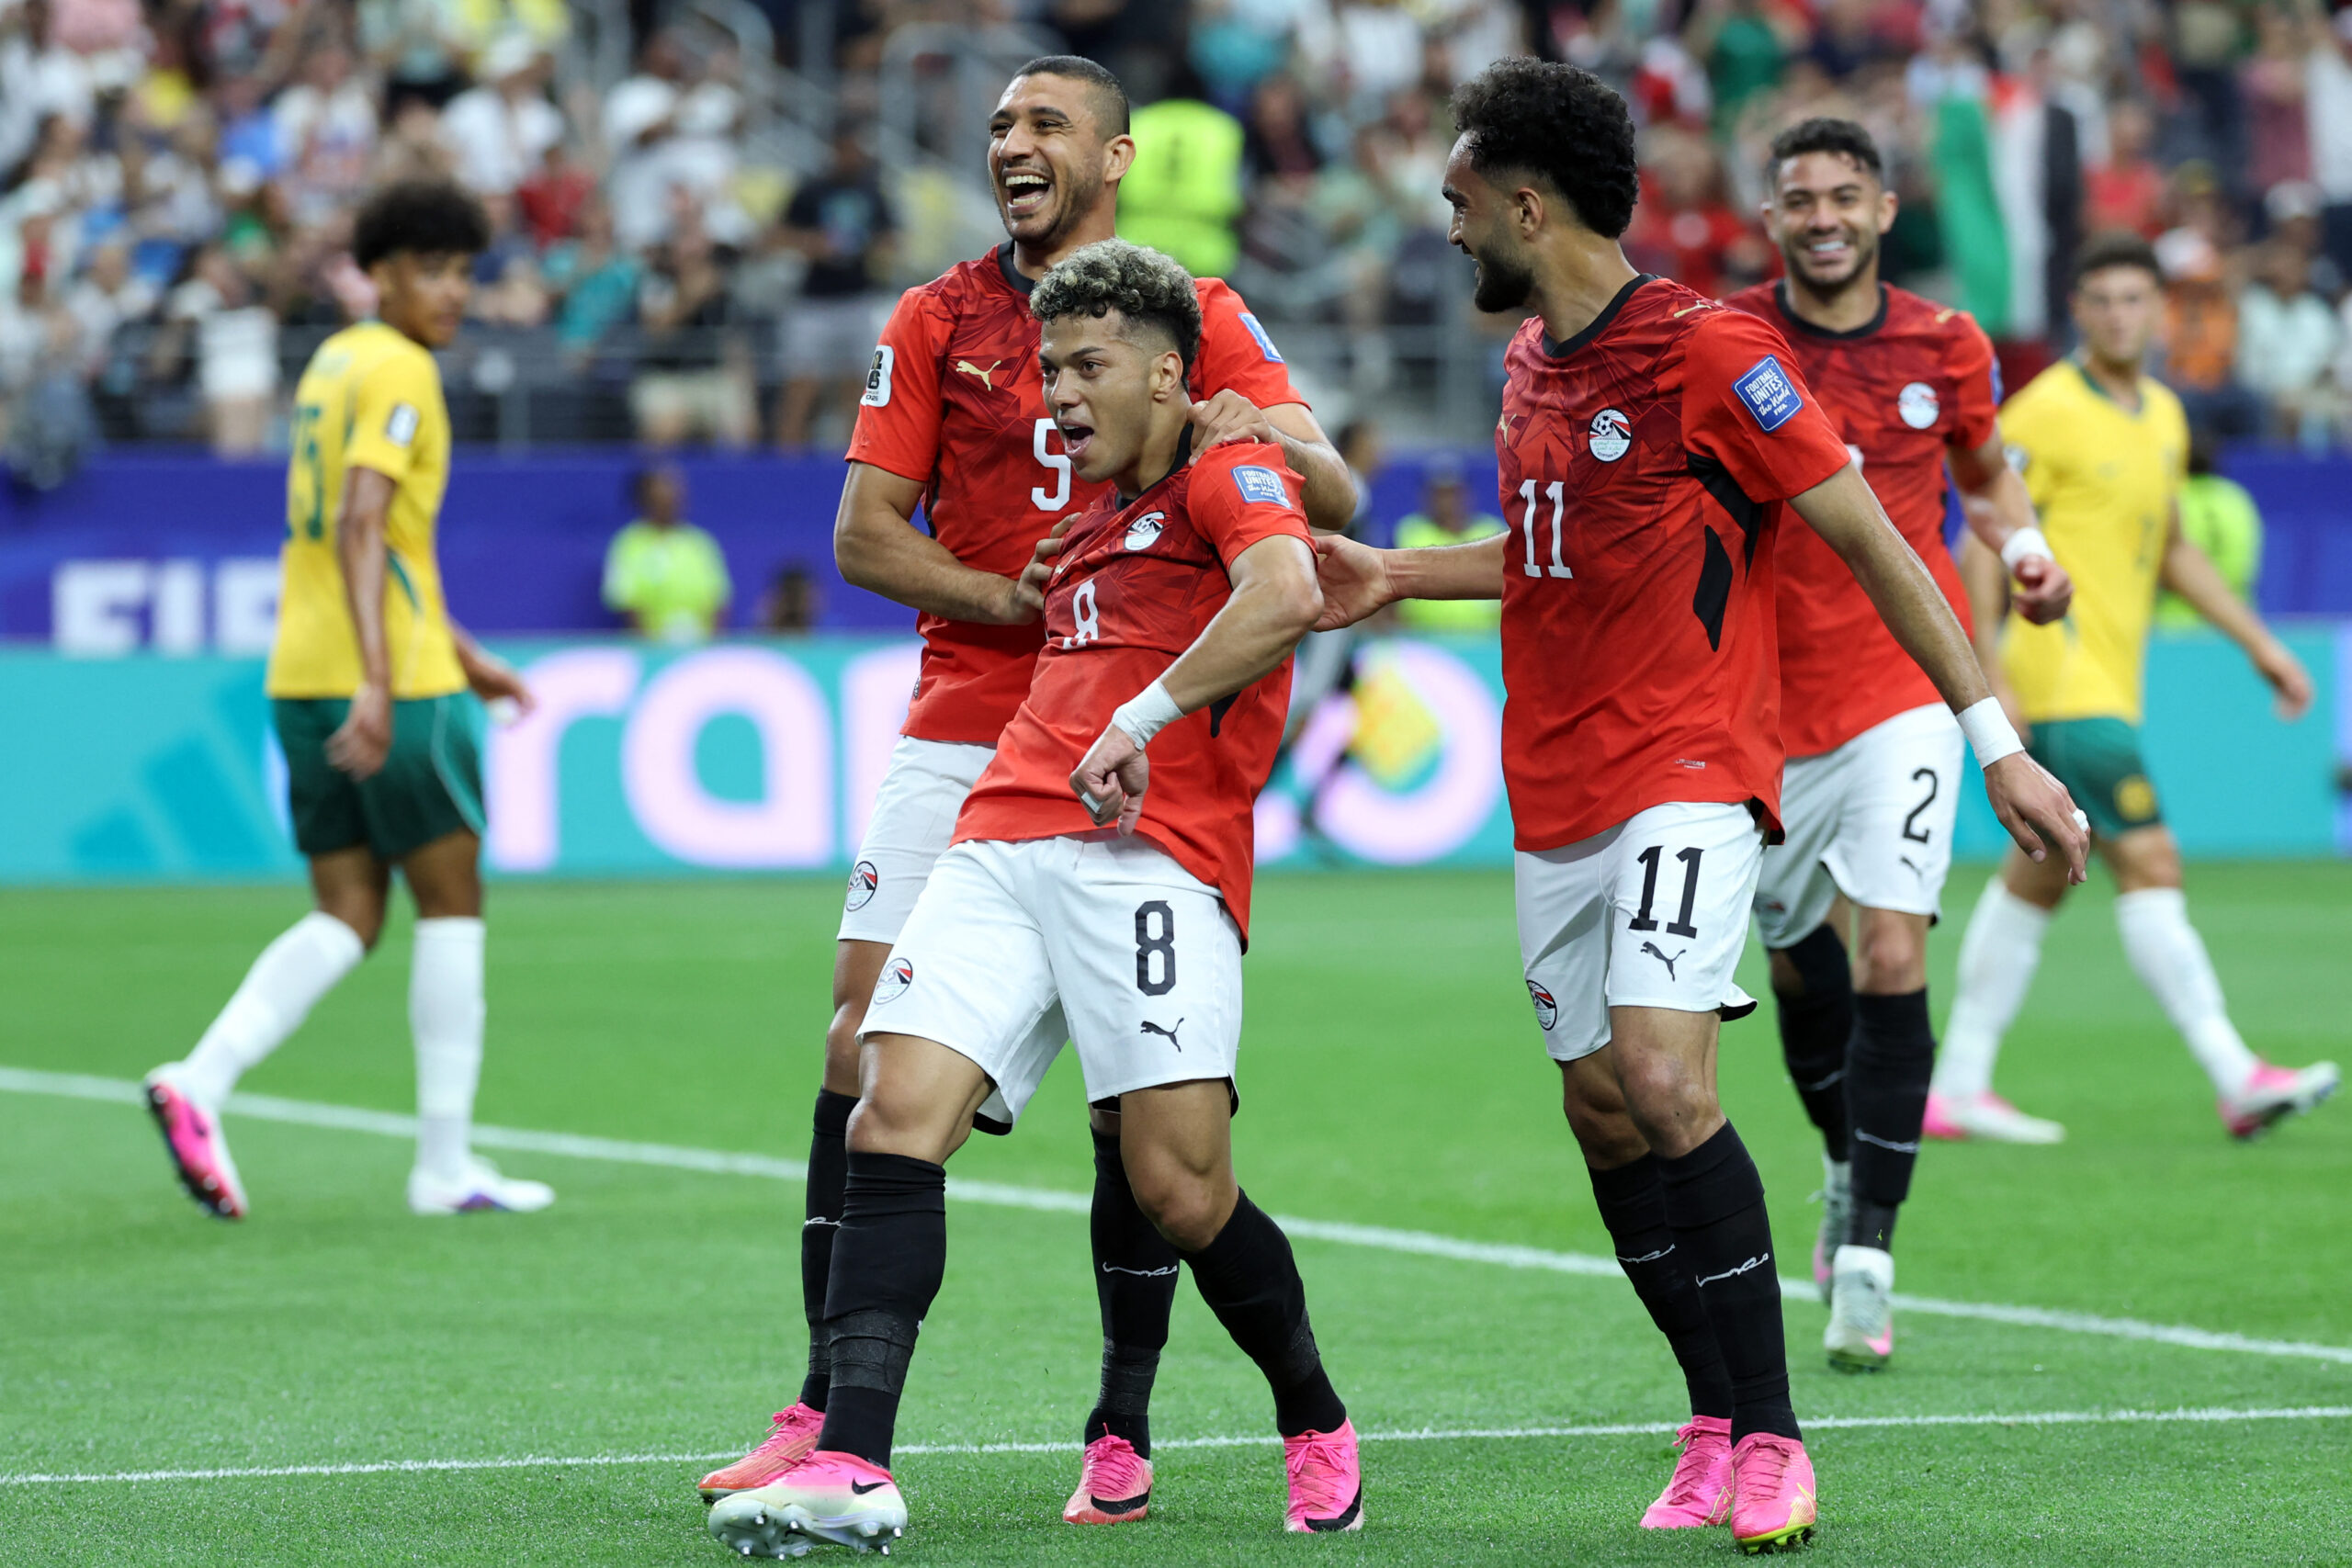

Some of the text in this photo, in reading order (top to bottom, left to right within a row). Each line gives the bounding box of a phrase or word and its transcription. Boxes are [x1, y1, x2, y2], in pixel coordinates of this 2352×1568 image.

[1745, 367, 1777, 396] FOOTBALL
[1750, 375, 1784, 405] UNITES
[1758, 385, 1791, 416] the World
[1773, 403, 1788, 416] FIFA
[1031, 417, 1071, 512] 5
[1519, 479, 1574, 580] 11
[52, 558, 280, 658] FIF
[1063, 578, 1100, 649] 8
[1902, 767, 1939, 844] 2
[1628, 845, 1705, 939] 11
[1135, 900, 1176, 997] 8
